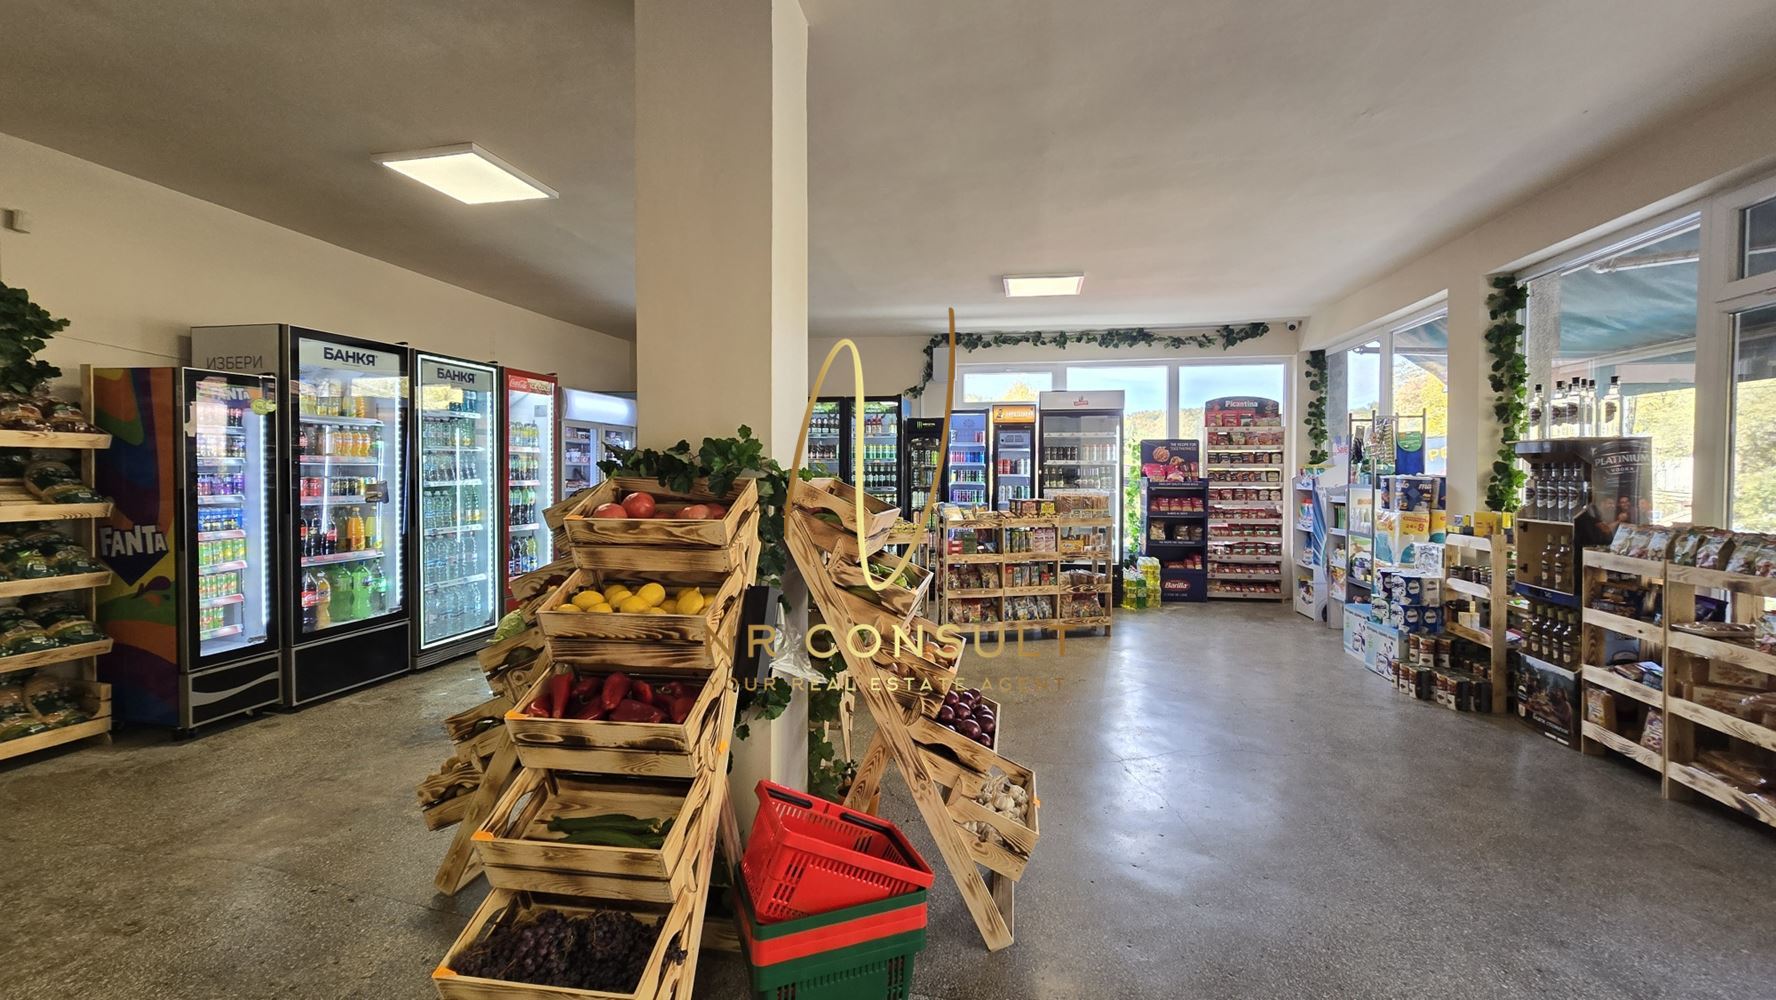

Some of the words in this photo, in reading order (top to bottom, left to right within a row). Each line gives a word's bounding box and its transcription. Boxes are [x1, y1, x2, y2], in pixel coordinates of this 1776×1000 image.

[206, 355, 263, 370] ИЗБЕРИ
[323, 346, 376, 366] БАНКЯ
[436, 367, 475, 384] БАНКЯ
[1225, 400, 1258, 408] Picantina
[1594, 453, 1650, 467] PLATINIUM
[100, 524, 167, 557] FANTA
